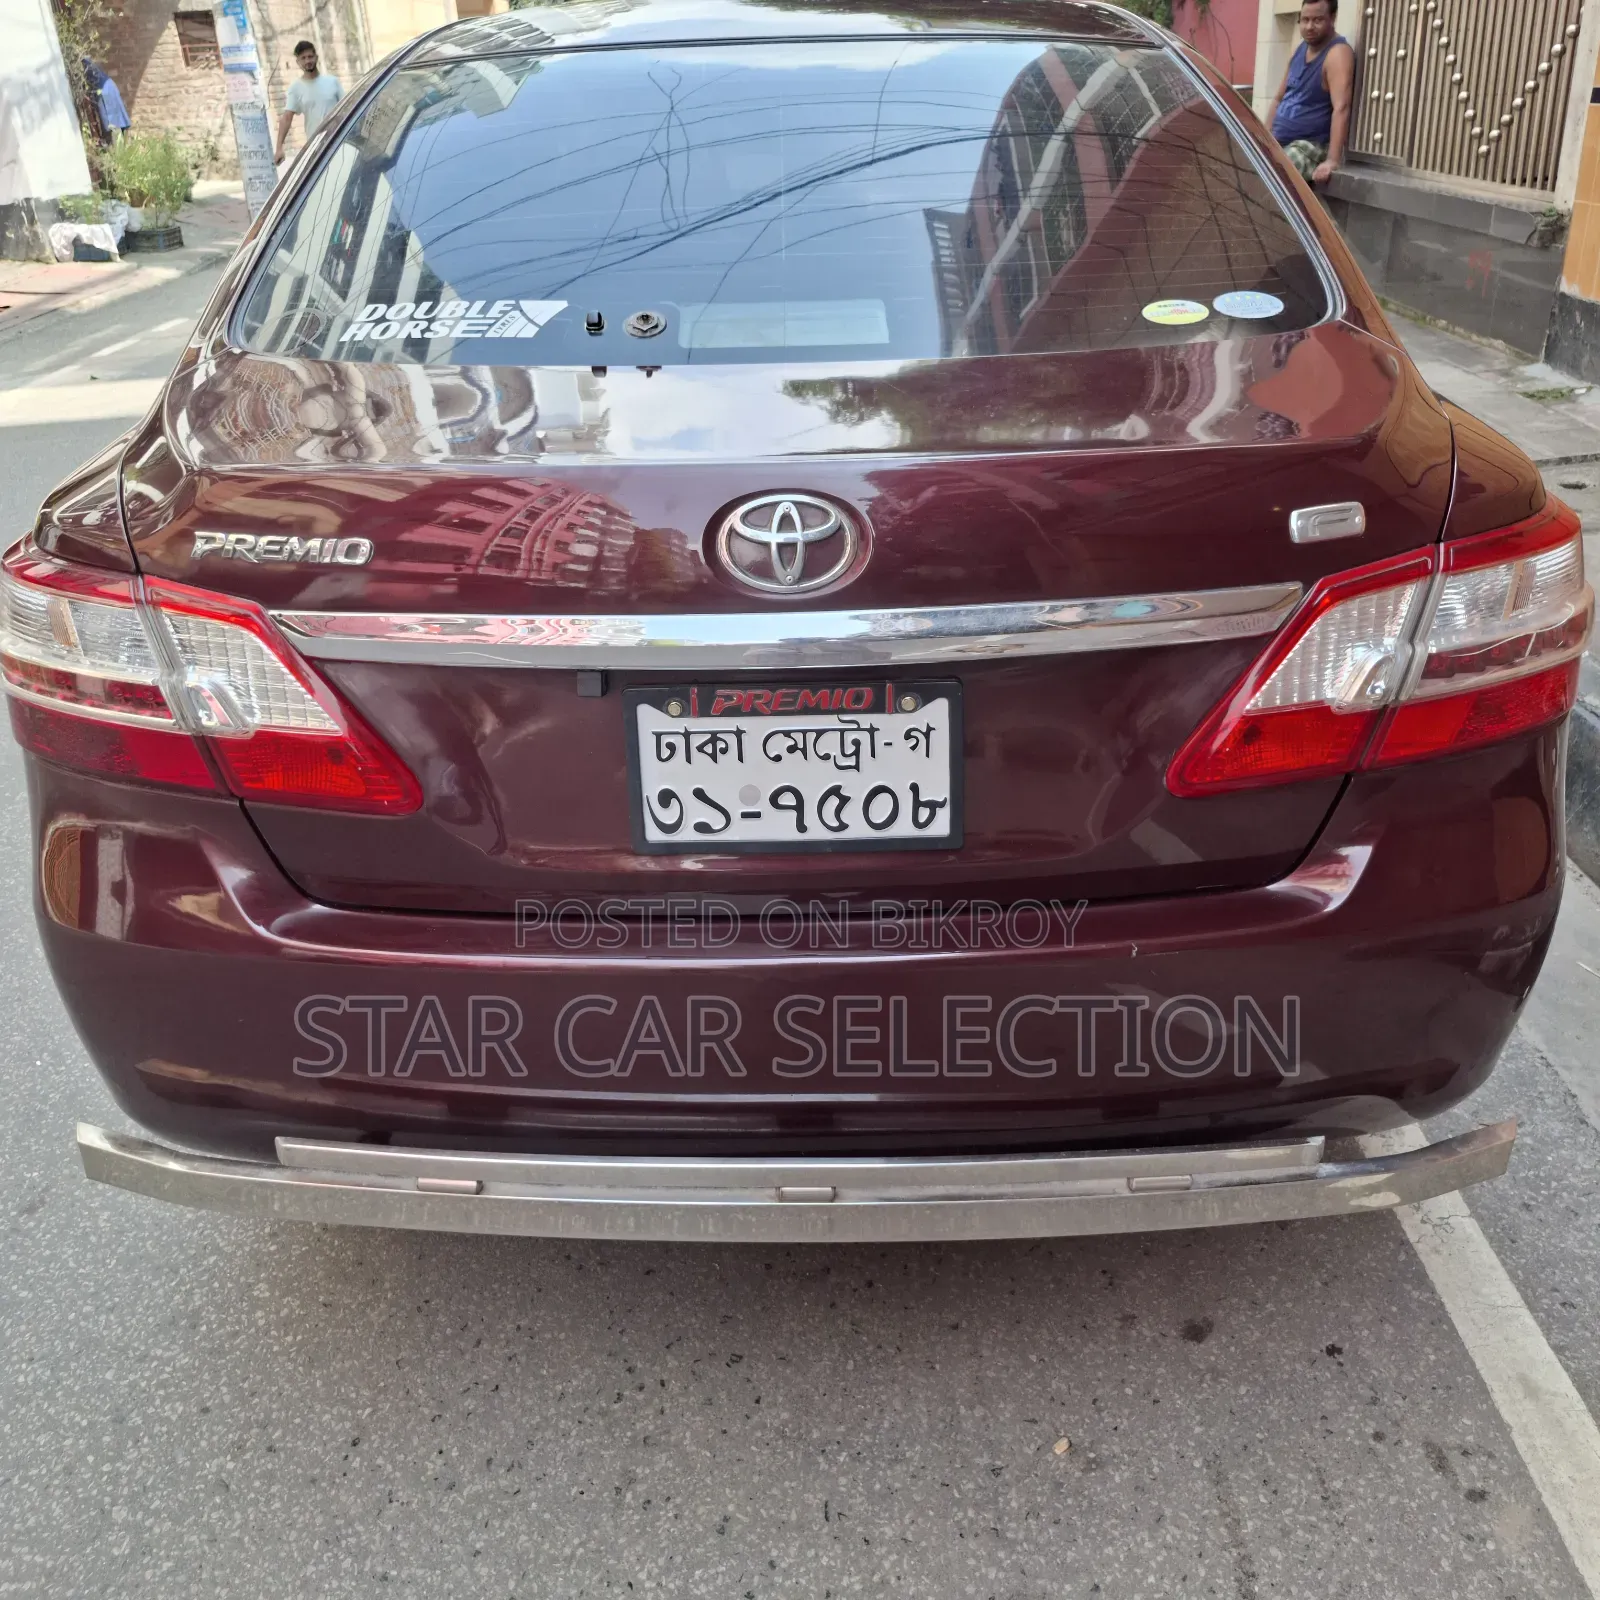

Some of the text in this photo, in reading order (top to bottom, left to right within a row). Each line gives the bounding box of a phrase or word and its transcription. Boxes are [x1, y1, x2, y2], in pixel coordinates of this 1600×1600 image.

[355, 300, 515, 322] DOUBLE
[339, 318, 497, 341] HORSE
[191, 531, 374, 565] PREMIO
[711, 686, 873, 715] PREMIO
[651, 724, 747, 765] ঢাকা
[645, 782, 948, 835] ৩১-৭৫০৮
